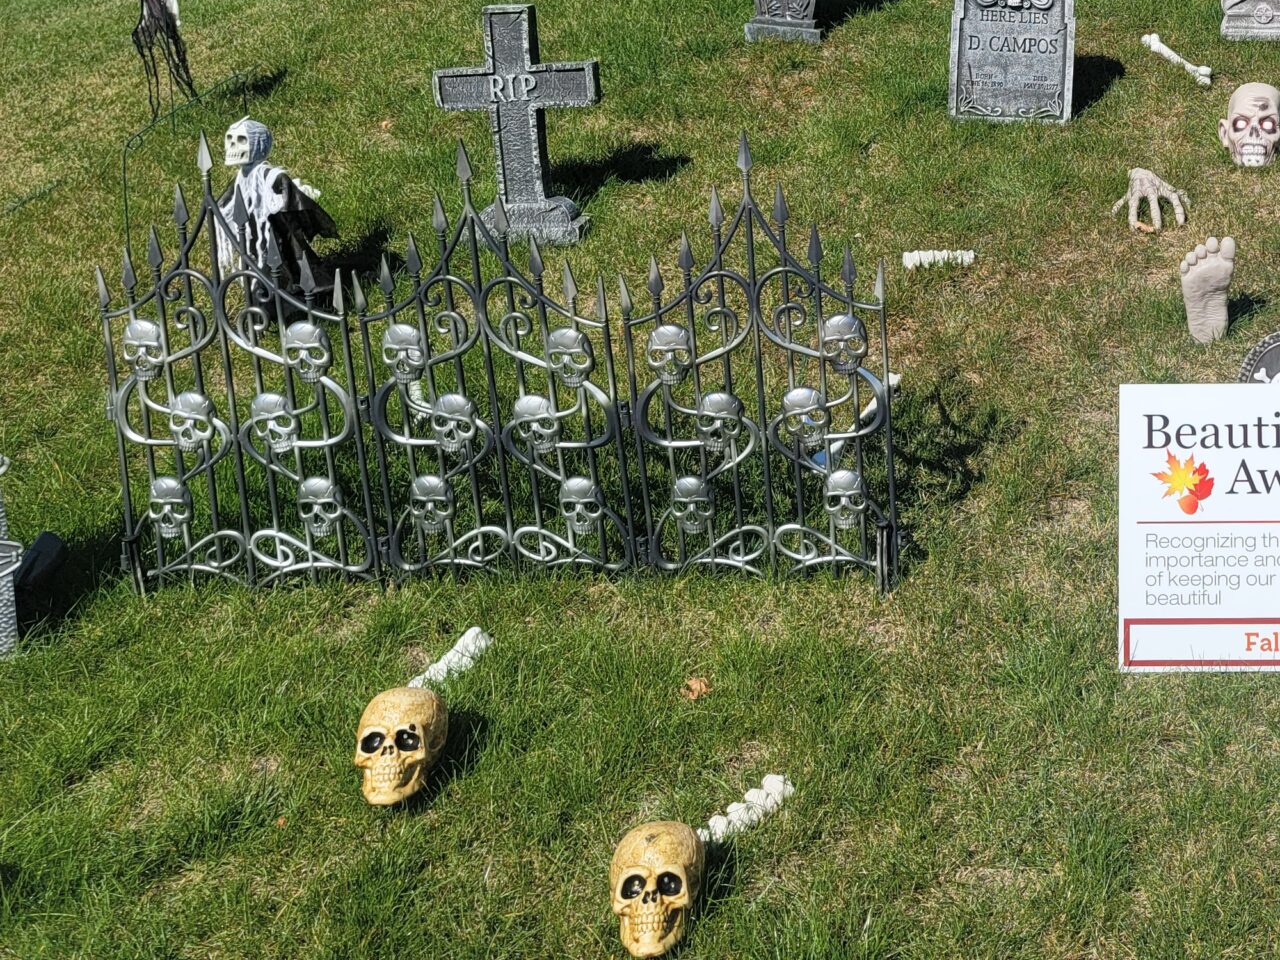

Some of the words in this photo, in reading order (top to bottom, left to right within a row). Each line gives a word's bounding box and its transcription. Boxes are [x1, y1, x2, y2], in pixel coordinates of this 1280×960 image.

[980, 9, 1017, 24] HERE
[1019, 11, 1049, 25] LIES
[968, 35, 984, 51] D.
[989, 36, 1058, 54] CAMPOS
[488, 74, 538, 103] RIP
[1145, 533, 1257, 552] Recognizing
[1145, 552, 1249, 570] importance
[1145, 571, 1165, 587] of
[1168, 570, 1241, 590] keeping
[1246, 574, 1276, 587] our
[1145, 589, 1222, 606] beautiful
